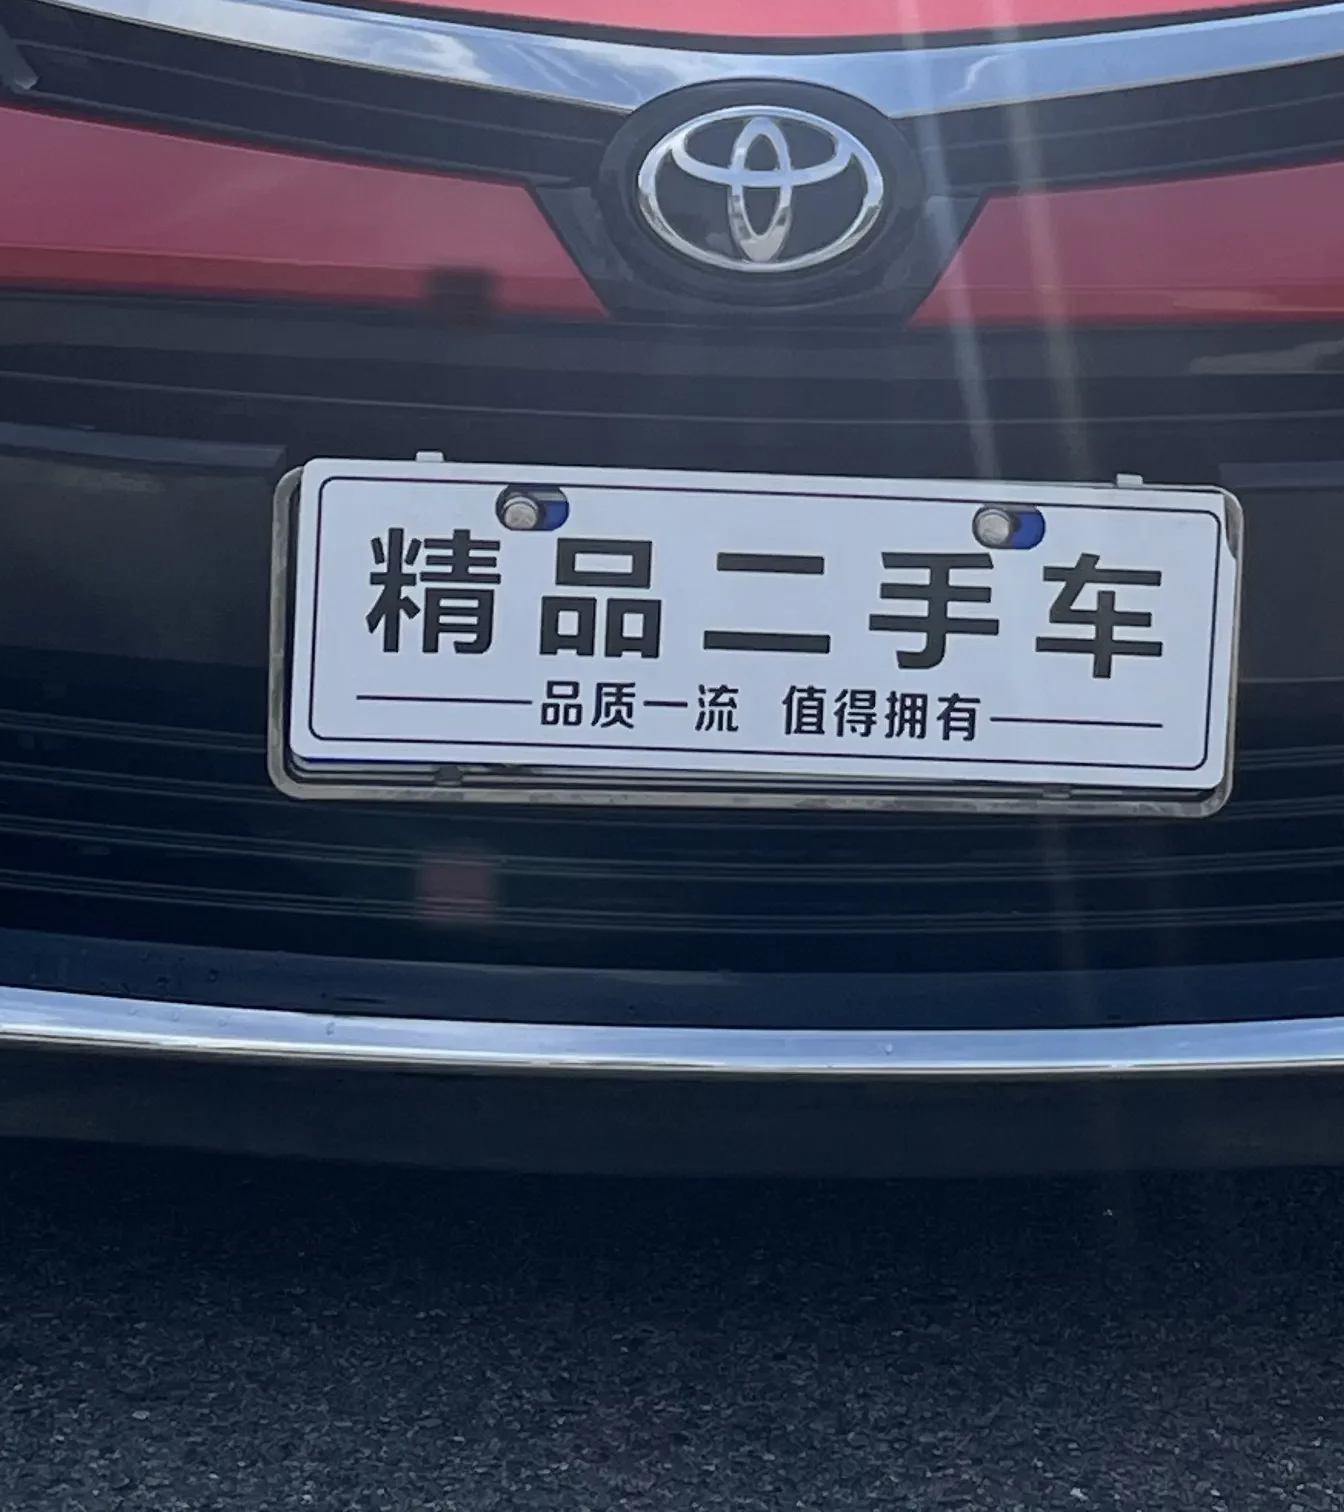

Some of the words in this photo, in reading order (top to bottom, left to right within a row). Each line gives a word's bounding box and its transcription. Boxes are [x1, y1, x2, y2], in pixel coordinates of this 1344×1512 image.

[365, 527, 1164, 679] 精品二手车
[540, 681, 740, 733] 品质一流
[781, 684, 982, 741] 值得拥有
